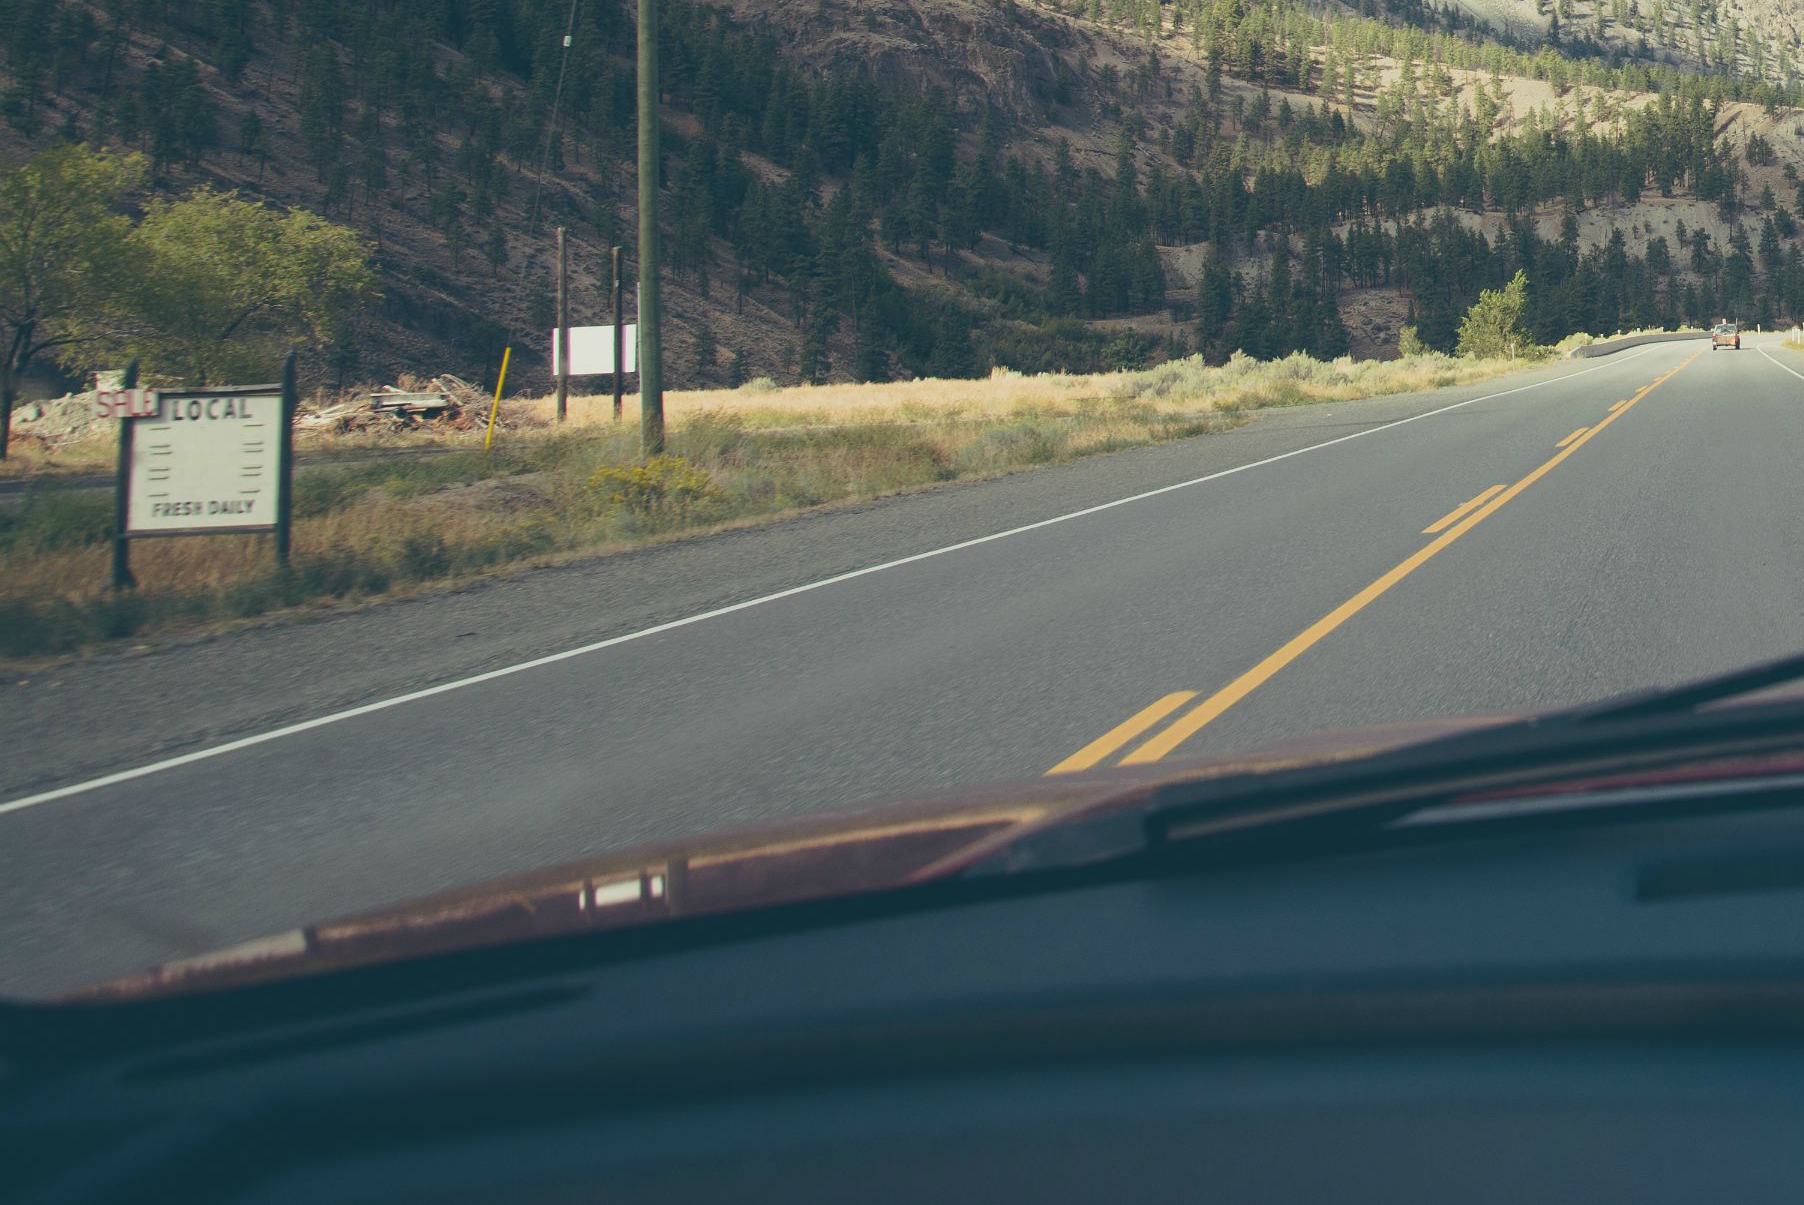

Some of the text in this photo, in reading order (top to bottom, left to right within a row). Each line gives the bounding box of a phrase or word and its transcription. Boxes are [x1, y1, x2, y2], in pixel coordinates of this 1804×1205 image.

[97, 390, 155, 417] SALE
[173, 398, 252, 420] LOCAL
[152, 500, 255, 516] FRESH DAILY
